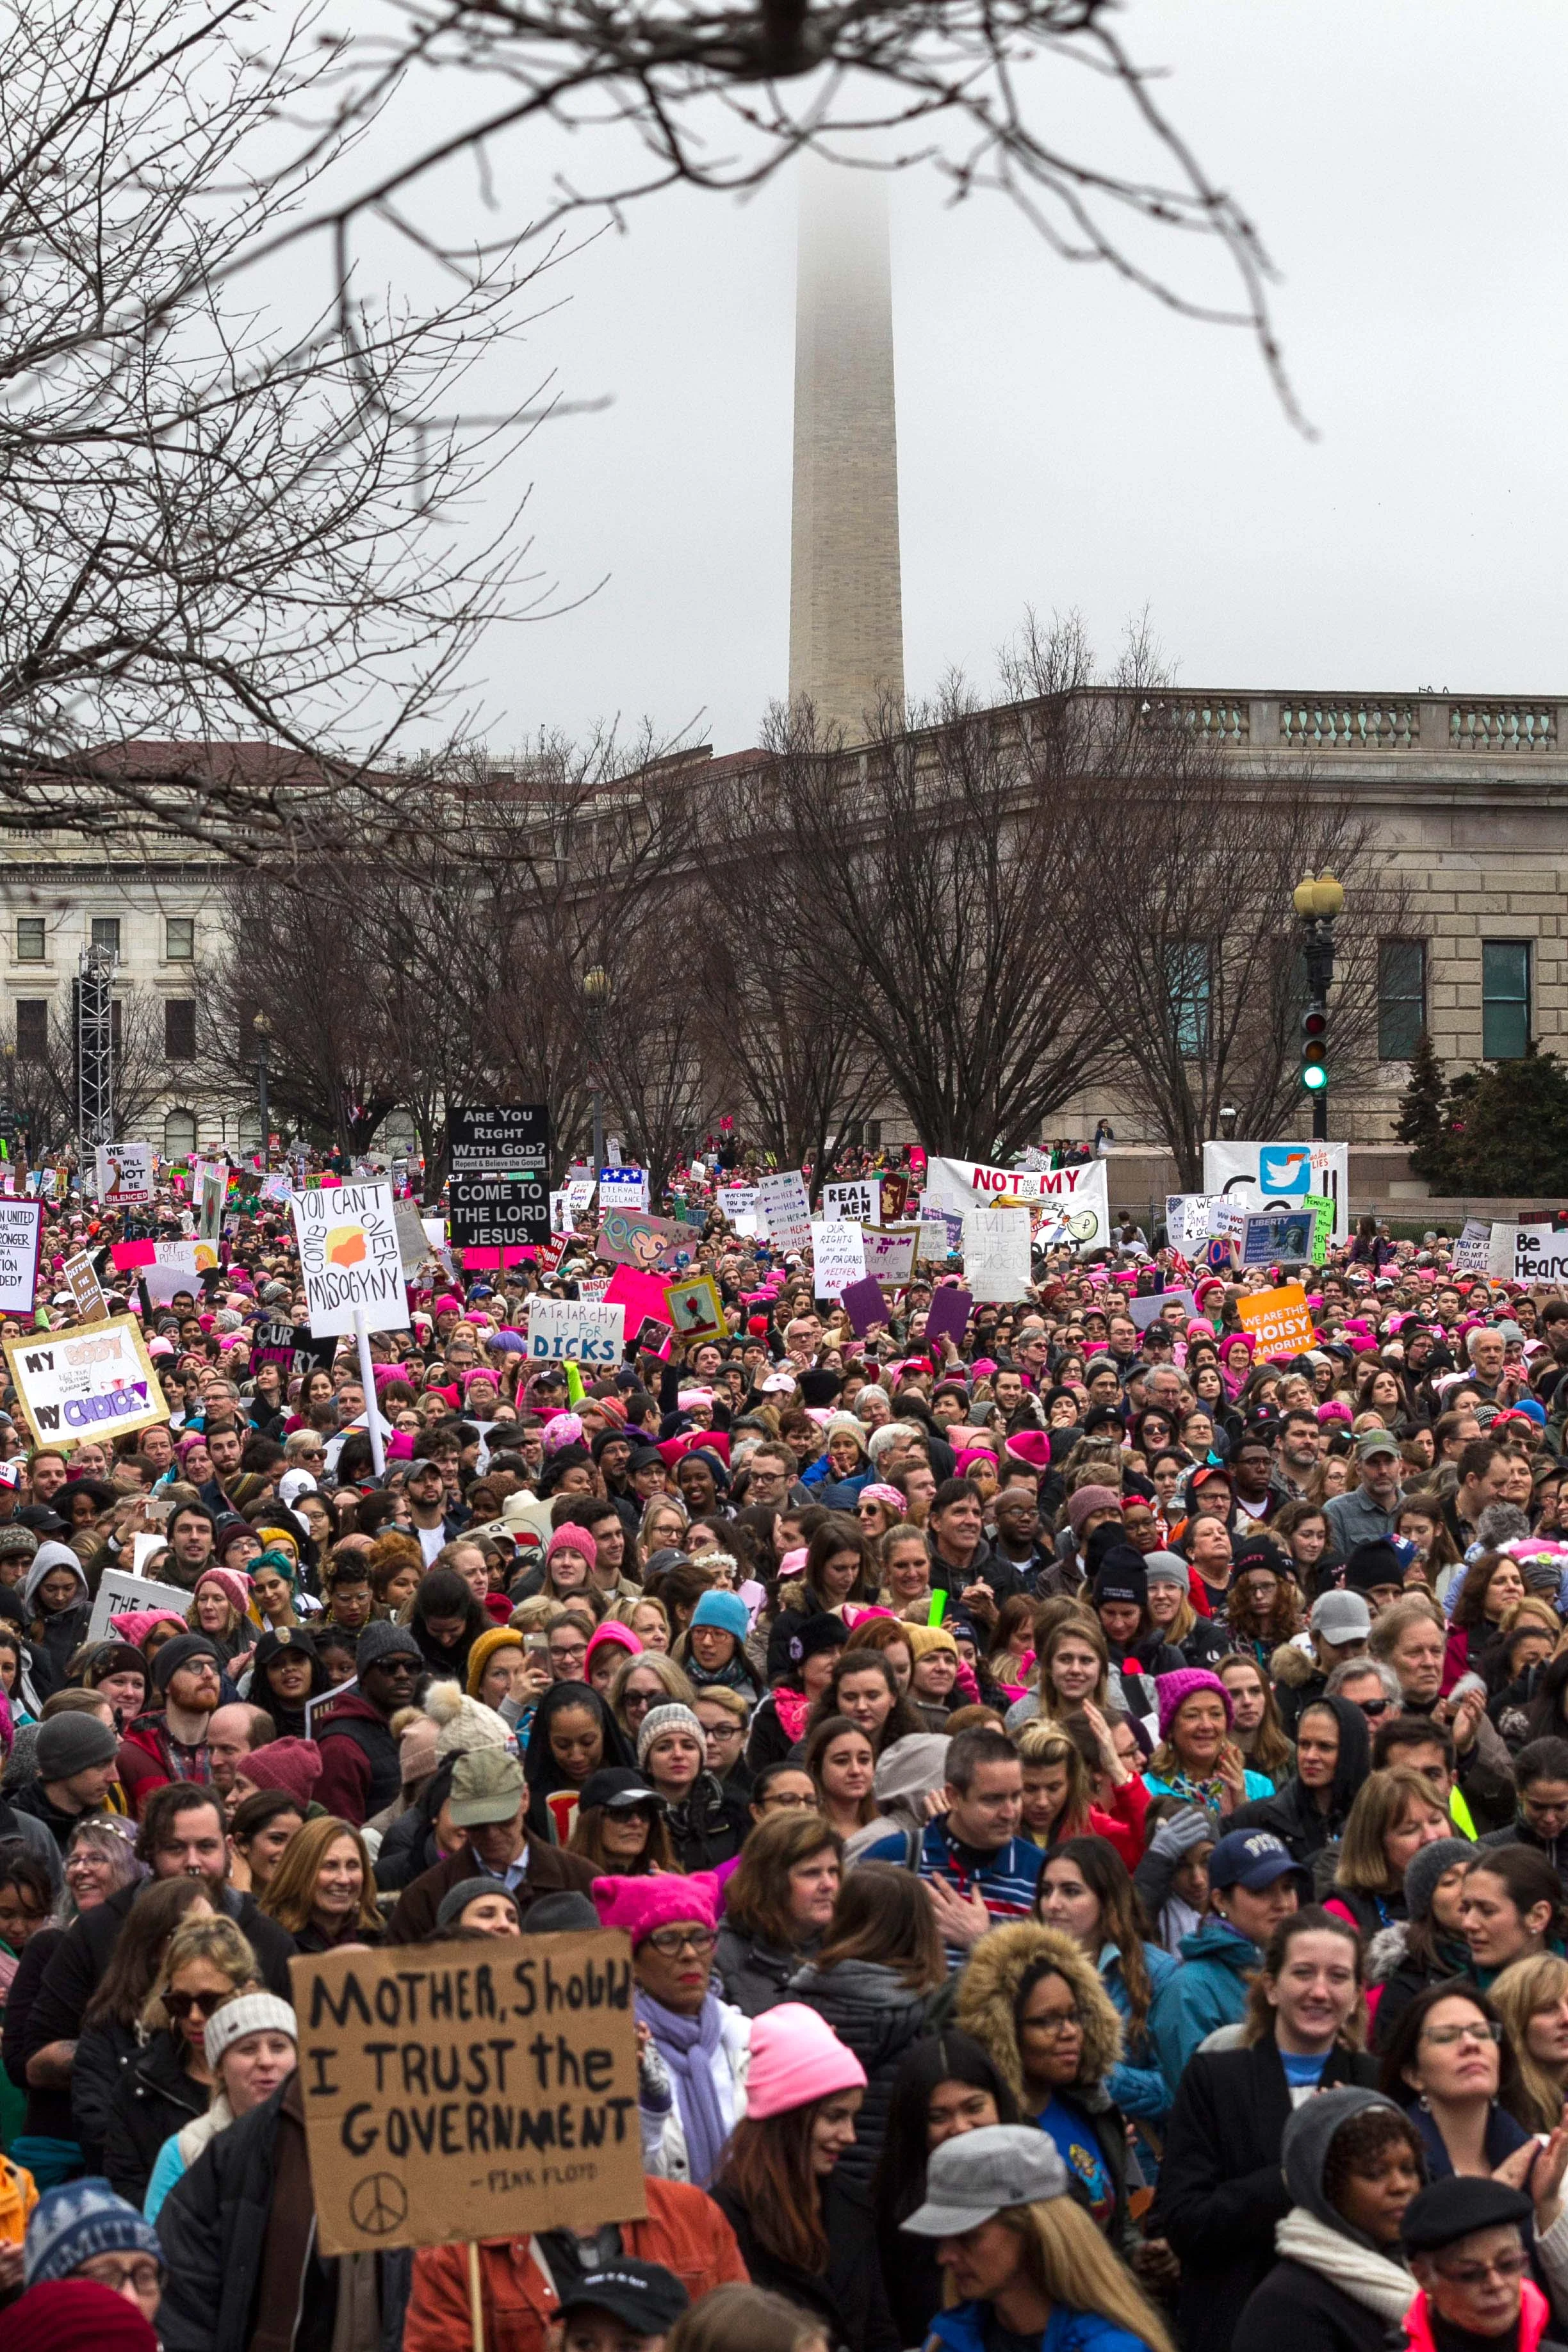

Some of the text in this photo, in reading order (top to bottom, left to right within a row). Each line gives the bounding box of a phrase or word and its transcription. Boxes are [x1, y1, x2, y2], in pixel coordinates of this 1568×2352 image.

[463, 1110, 532, 1122] ARE YOU
[474, 1128, 523, 1139] RIGHT
[106, 1146, 125, 1156] WE
[453, 1143, 545, 1156] WITH GOD?
[455, 1160, 478, 1170] Repent
[521, 1158, 543, 1168] Gospel
[1312, 1159, 1328, 1169] LIES
[120, 1170, 145, 1180] NOT
[972, 1168, 1024, 1194] NOT
[1040, 1170, 1079, 1194] MY
[106, 1191, 147, 1202] SILENCED
[458, 1184, 542, 1201] COME TO
[601, 1186, 639, 1194] ETERNAL
[781, 1191, 794, 1200] HER
[828, 1186, 870, 1202] REAL
[292, 1191, 325, 1221] YOU
[332, 1184, 385, 1215] CAN'T
[601, 1196, 641, 1204] VIGILANCE
[1196, 1194, 1242, 1209] WE ALL
[453, 1207, 490, 1223] THE
[496, 1205, 547, 1222] LORD
[840, 1200, 870, 1216] MEN
[7, 1211, 34, 1224] UNITED
[787, 1213, 801, 1222] HER
[1189, 1216, 1208, 1228] AME
[1218, 1211, 1243, 1224] We WO
[1250, 1218, 1289, 1227] LIBERTY
[790, 1225, 804, 1234] HER
[826, 1224, 845, 1234] OUR
[1228, 1225, 1243, 1234] BAC
[0, 1234, 29, 1246] RONGER
[361, 1213, 398, 1266] OVER
[469, 1227, 534, 1245] JESUS.
[792, 1236, 807, 1247] HER
[819, 1235, 853, 1244] RIGHTS
[1516, 1233, 1540, 1252] Be
[163, 1243, 178, 1253] OFF
[303, 1225, 327, 1273] COMB
[1457, 1240, 1471, 1248] MEN
[159, 1251, 191, 1262] PUSSIES
[819, 1255, 863, 1264] UP FOR GRABS
[1456, 1257, 1488, 1268] EQUALI
[0, 1259, 17, 1271] TION
[67, 1260, 90, 1278] DEFEND
[824, 1268, 857, 1276] NEITHER
[0, 1275, 22, 1286] DED!
[78, 1276, 90, 1287] THE
[582, 1279, 611, 1292] MISOG
[78, 1285, 99, 1304] SACRED
[308, 1267, 398, 1312] MISOGYNY
[530, 1299, 617, 1328] PATRIARCHY
[1242, 1303, 1306, 1328] WE ARE THE
[257, 1324, 295, 1349] OUR
[555, 1322, 602, 1338] IS FOR
[533, 1335, 615, 1360] DICKS
[1257, 1333, 1312, 1355] MAJORITY
[24, 1336, 122, 1373] MY BODY
[33, 1403, 60, 1430] MY
[310, 1958, 633, 2029] MOTHER, Should
[309, 2032, 614, 2096] I TRUST the
[341, 2098, 634, 2157] GOVERNMENT
[543, 2162, 598, 2188] FLOYD
